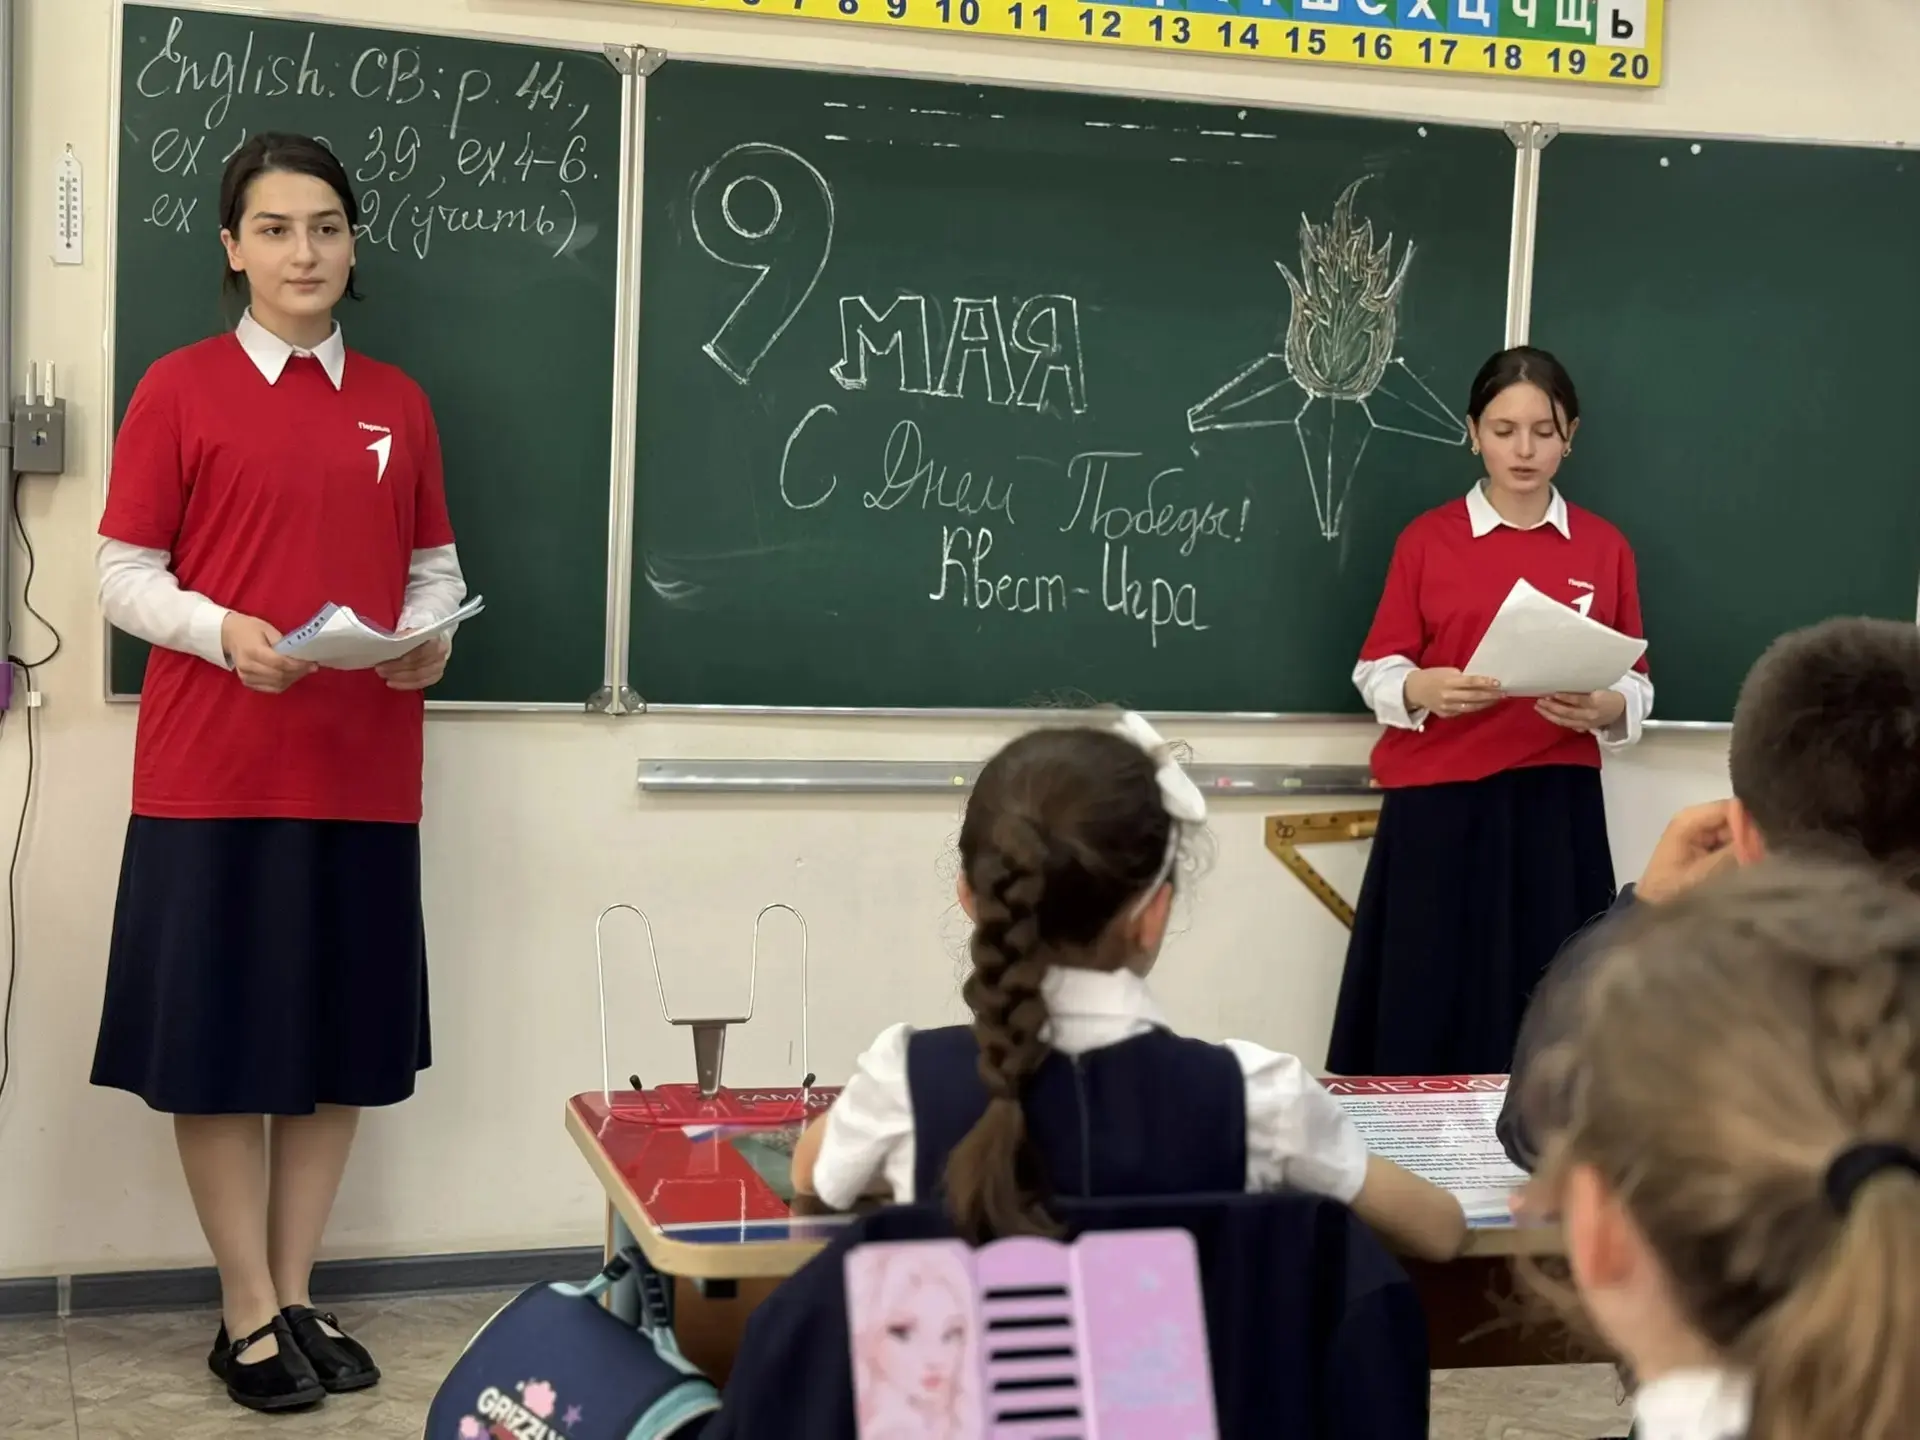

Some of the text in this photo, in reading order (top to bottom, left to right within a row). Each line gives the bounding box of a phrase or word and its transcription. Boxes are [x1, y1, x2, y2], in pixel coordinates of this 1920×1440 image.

[935, 0, 980, 26] 10
[1008, 2, 1048, 32] 11
[1079, 8, 1122, 38] 12
[1148, 14, 1191, 44] 13
[1217, 20, 1259, 50] 14
[1285, 26, 1327, 56] 15
[1352, 32, 1393, 61] 16
[1418, 37, 1459, 66] 17
[1483, 42, 1522, 71] 18
[1546, 47, 1587, 75] 19
[1608, 52, 1650, 80] 20
[1555, 0, 1592, 36] Щ
[689, 142, 1088, 414] 9 МАЯ
[779, 403, 838, 510] С
[1059, 451, 1252, 557] Победы!
